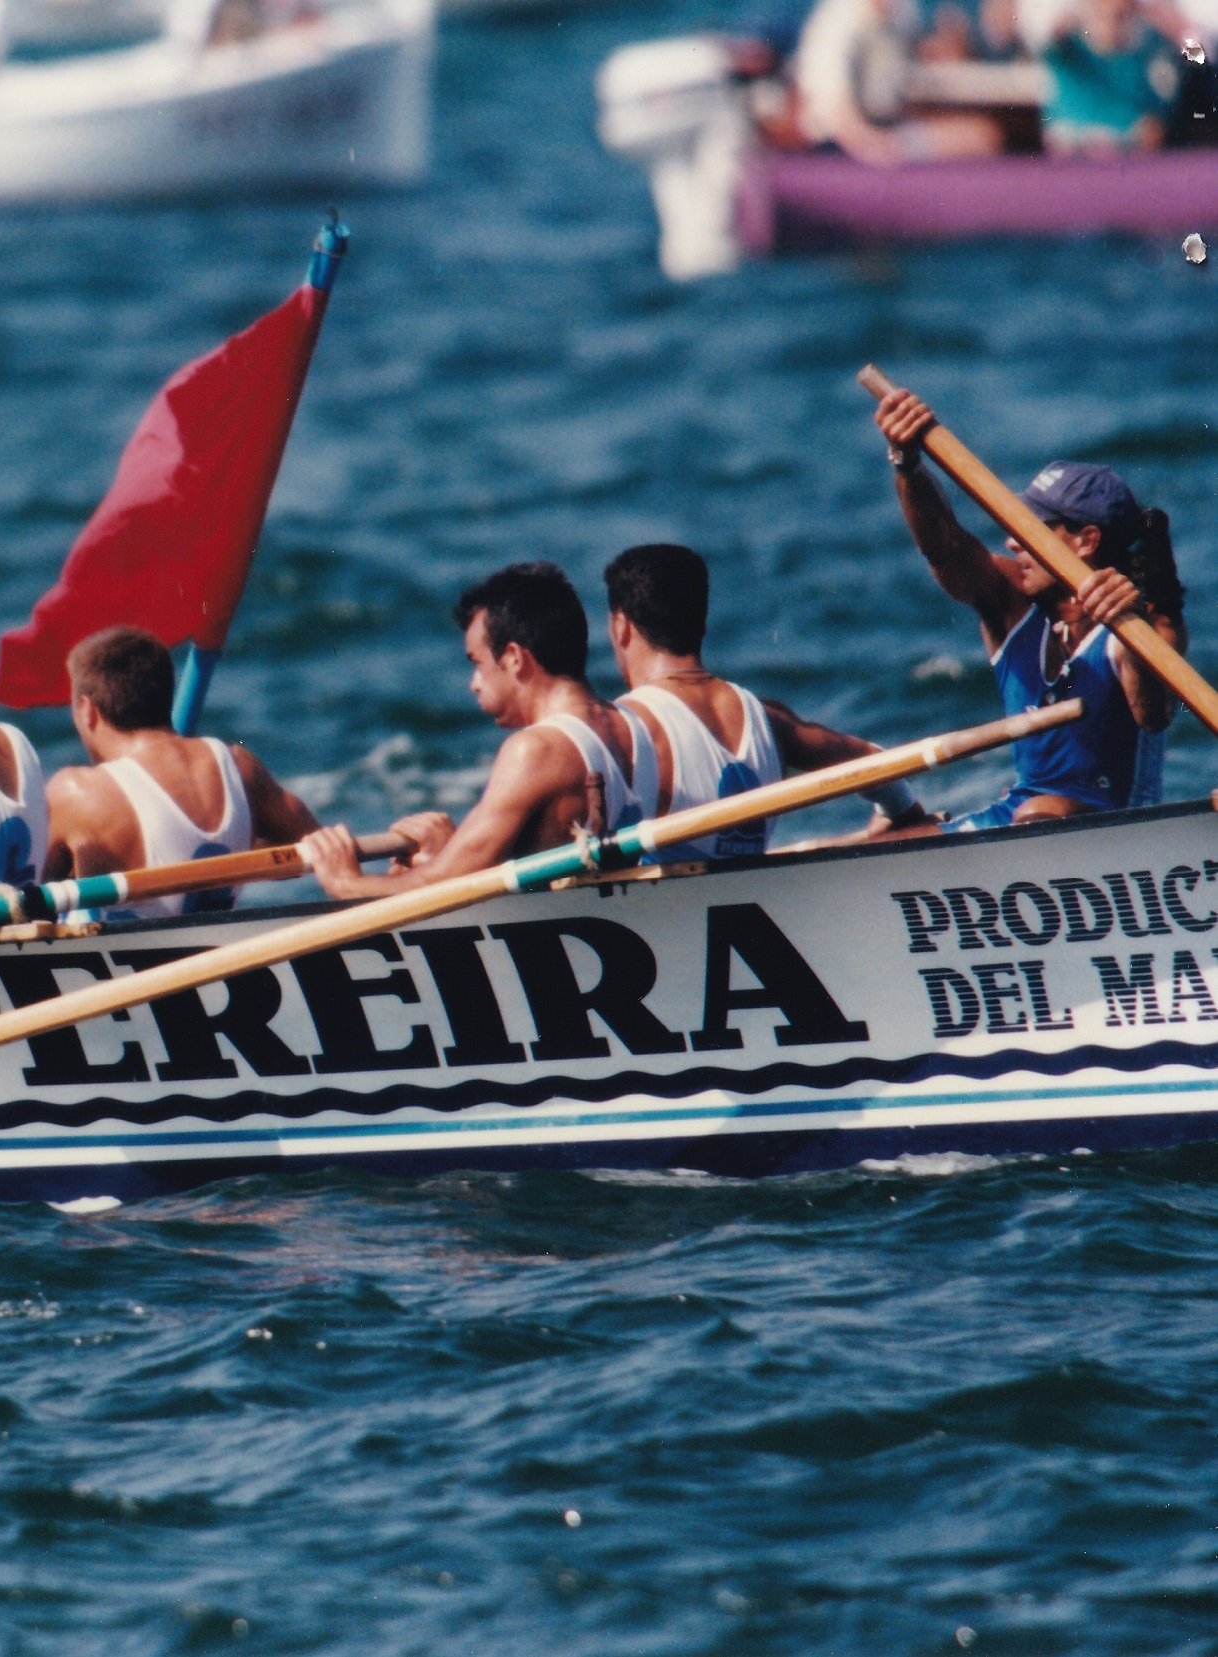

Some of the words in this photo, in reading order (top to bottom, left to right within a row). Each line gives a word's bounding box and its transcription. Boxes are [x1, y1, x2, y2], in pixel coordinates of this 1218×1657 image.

[890, 860, 1218, 953] PRODUC
[917, 960, 1074, 1038] DEL
[1091, 948, 1218, 1027] MA
